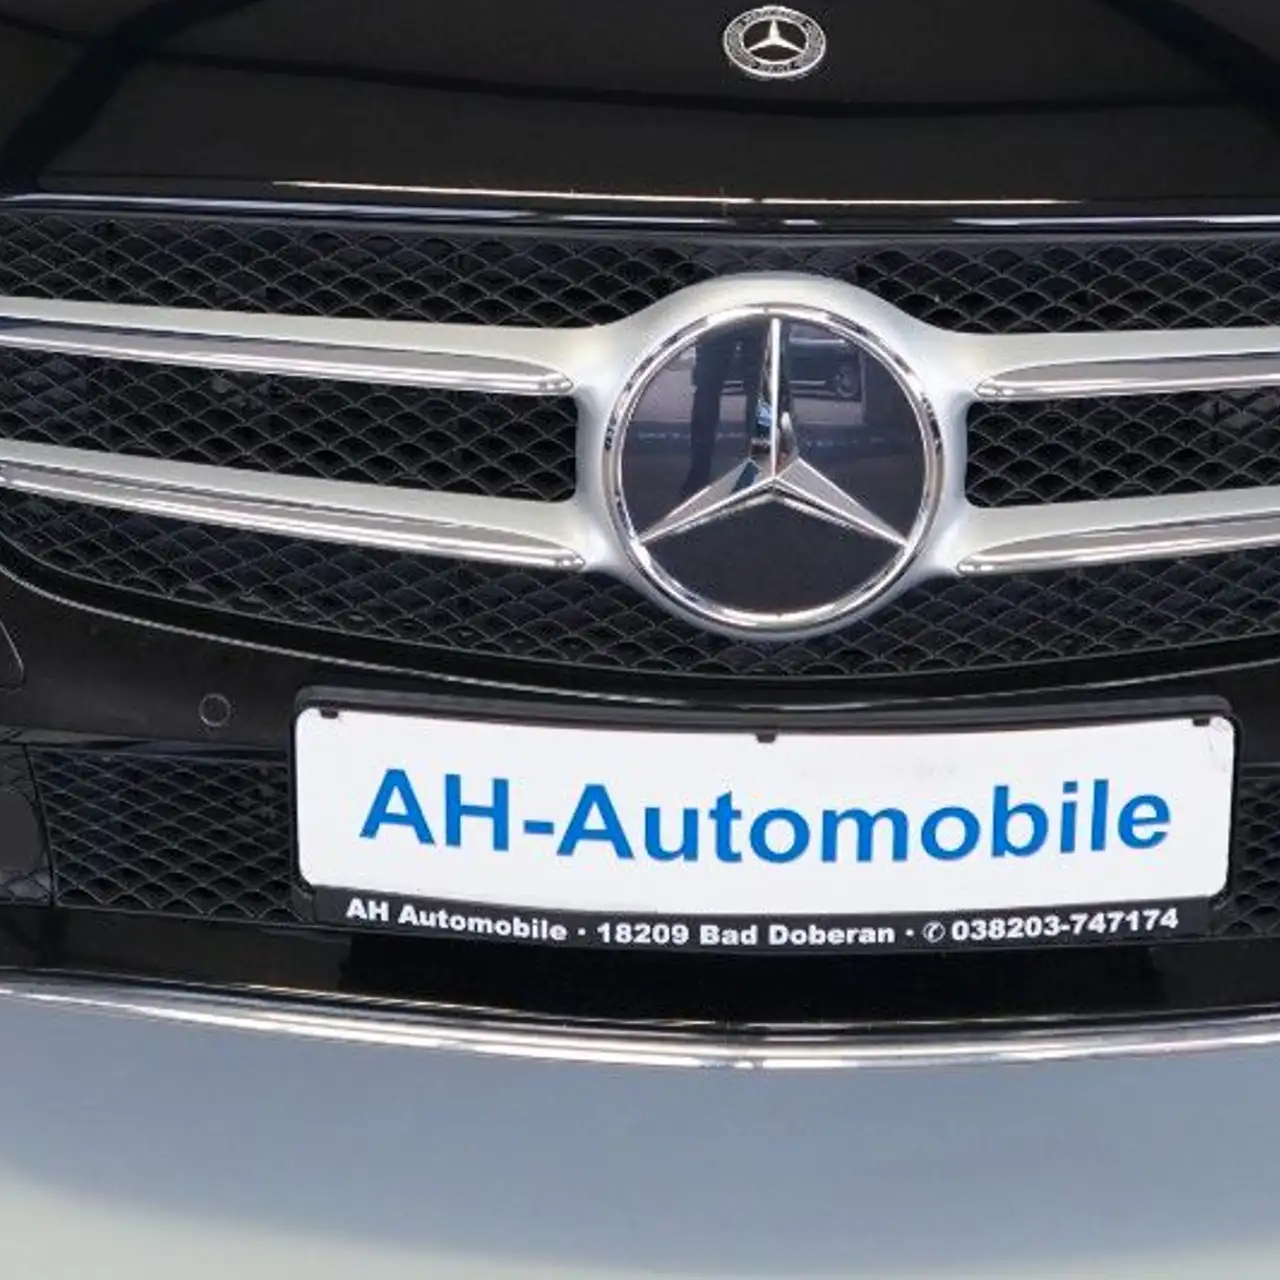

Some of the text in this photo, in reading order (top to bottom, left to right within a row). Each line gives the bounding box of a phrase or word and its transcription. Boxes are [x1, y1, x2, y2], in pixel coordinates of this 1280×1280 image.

[358, 768, 1171, 864] AH-Automobile
[346, 897, 1180, 946] AH Automobile 18209 Bad Doberan 038203-747174
